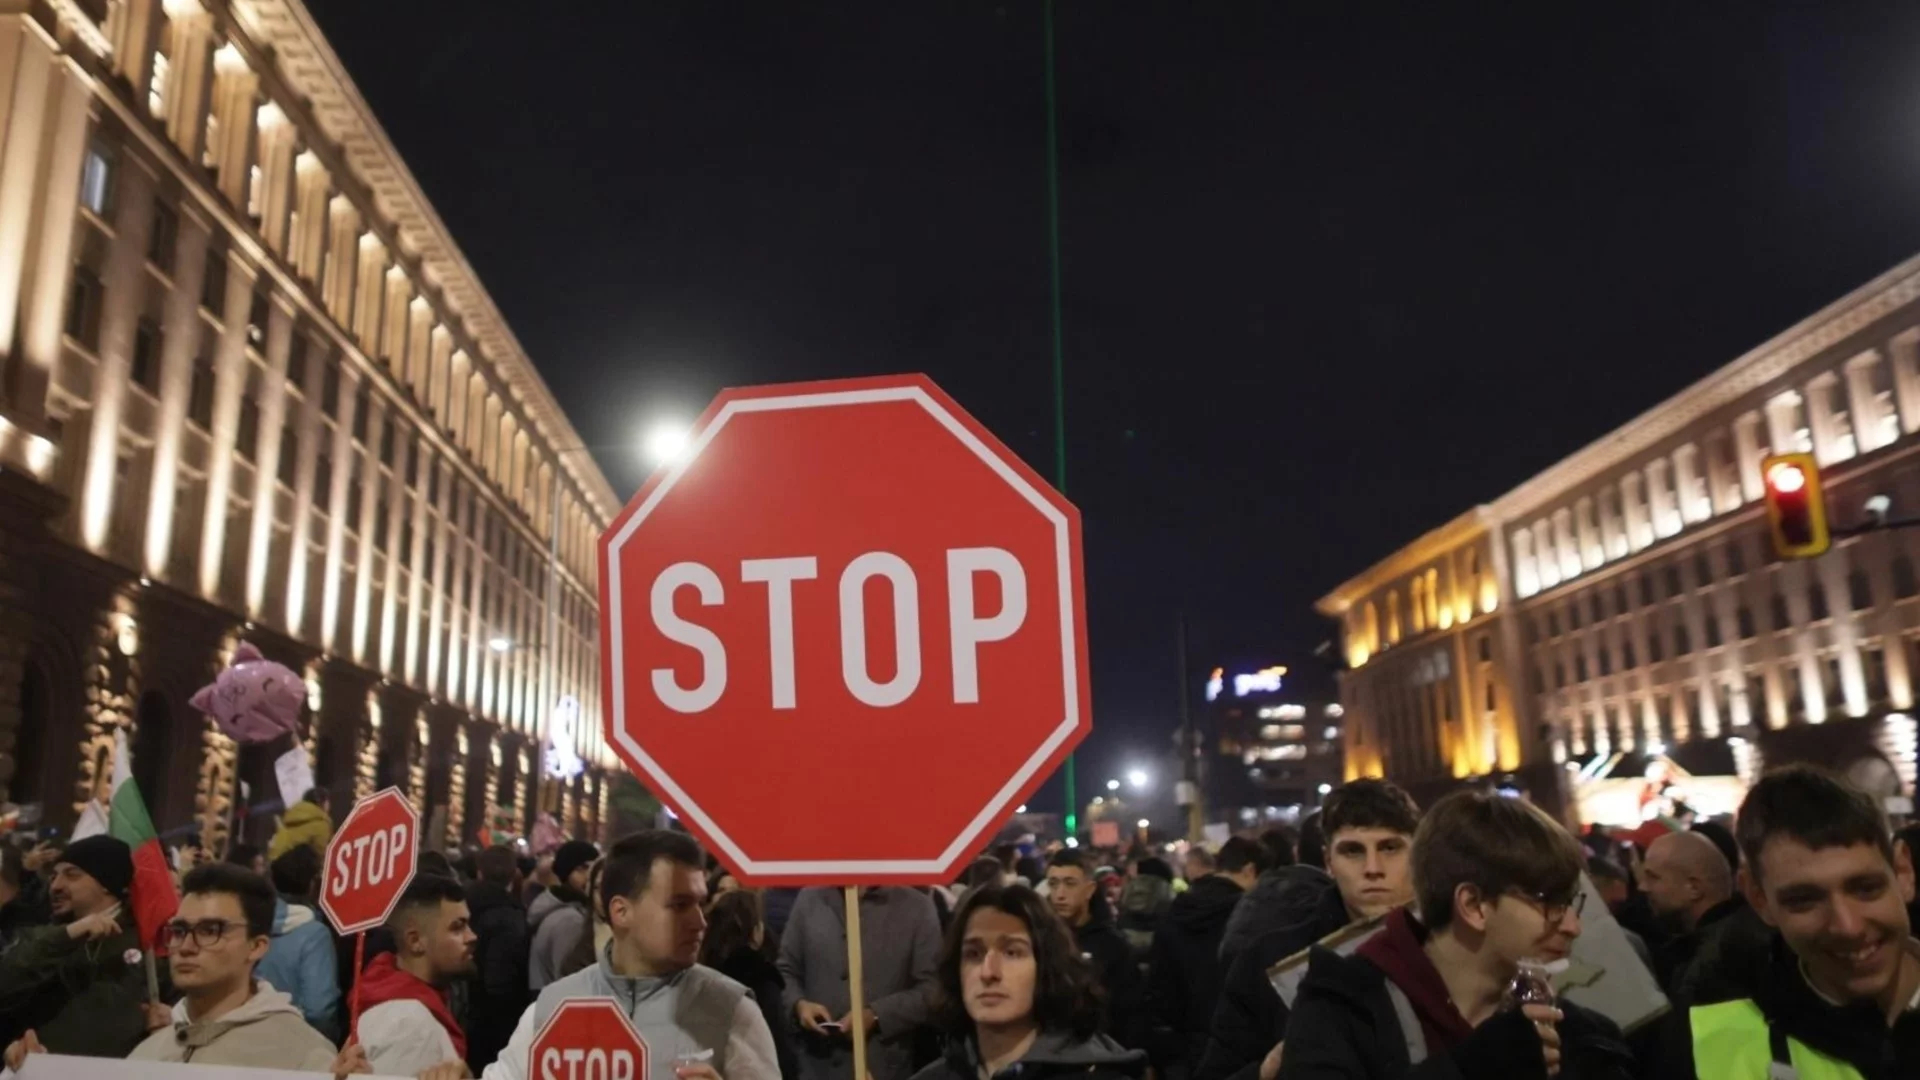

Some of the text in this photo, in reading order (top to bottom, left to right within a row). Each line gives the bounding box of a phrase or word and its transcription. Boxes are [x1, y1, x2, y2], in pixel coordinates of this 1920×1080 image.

[650, 546, 1028, 713] STOP
[331, 823, 408, 897] STOP
[541, 1046, 634, 1080] STOP
